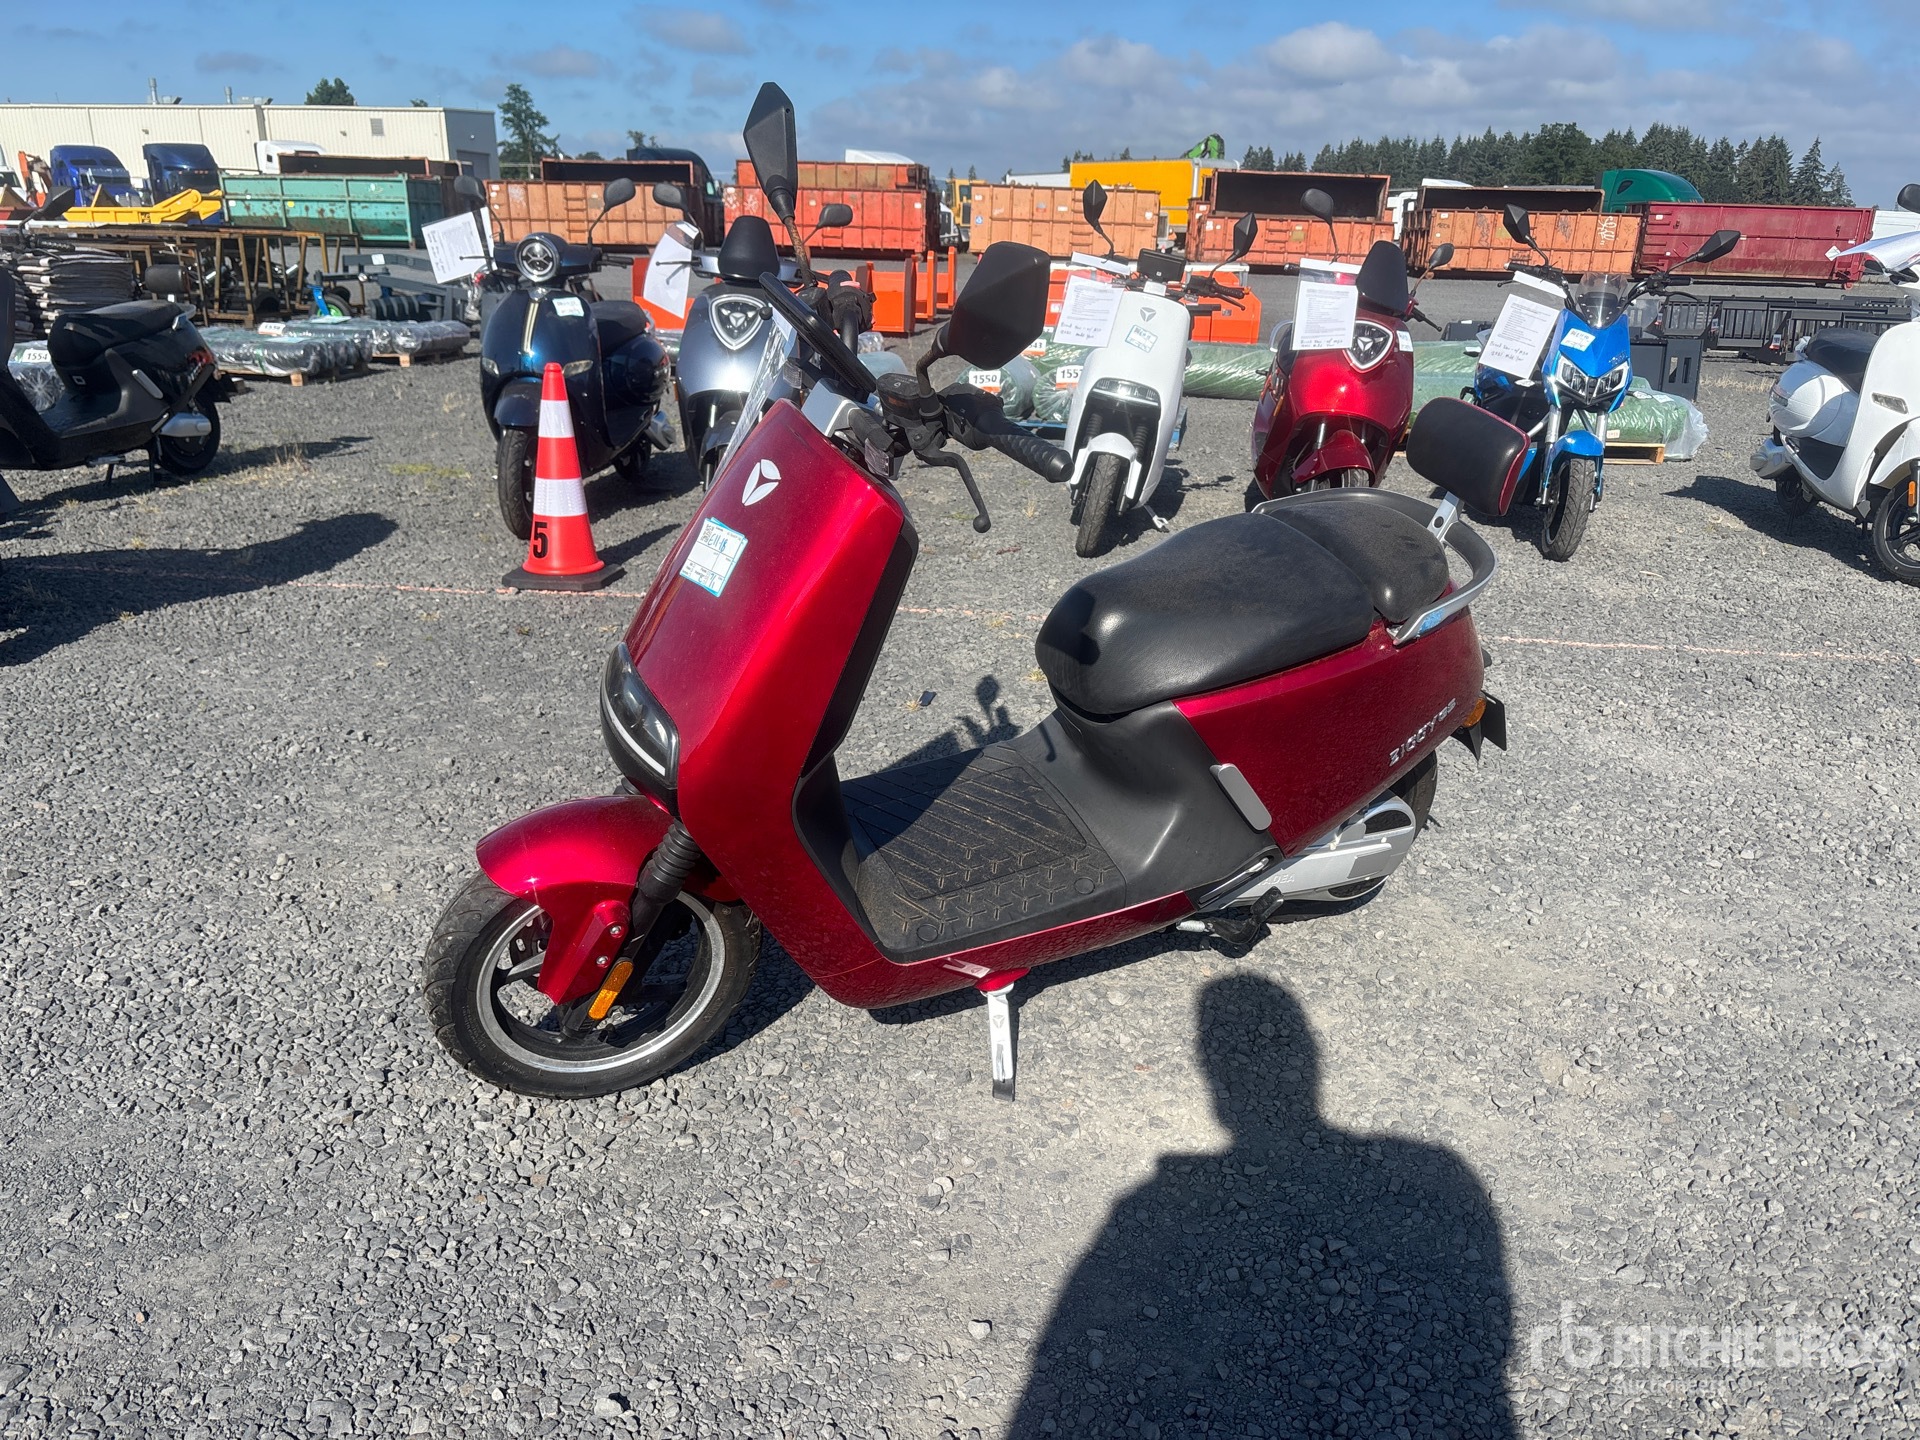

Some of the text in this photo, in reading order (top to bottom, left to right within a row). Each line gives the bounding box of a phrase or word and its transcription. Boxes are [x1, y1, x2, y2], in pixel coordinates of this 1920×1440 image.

[972, 374, 998, 384] 1550
[1060, 369, 1083, 379] 155
[533, 521, 548, 558] 5
